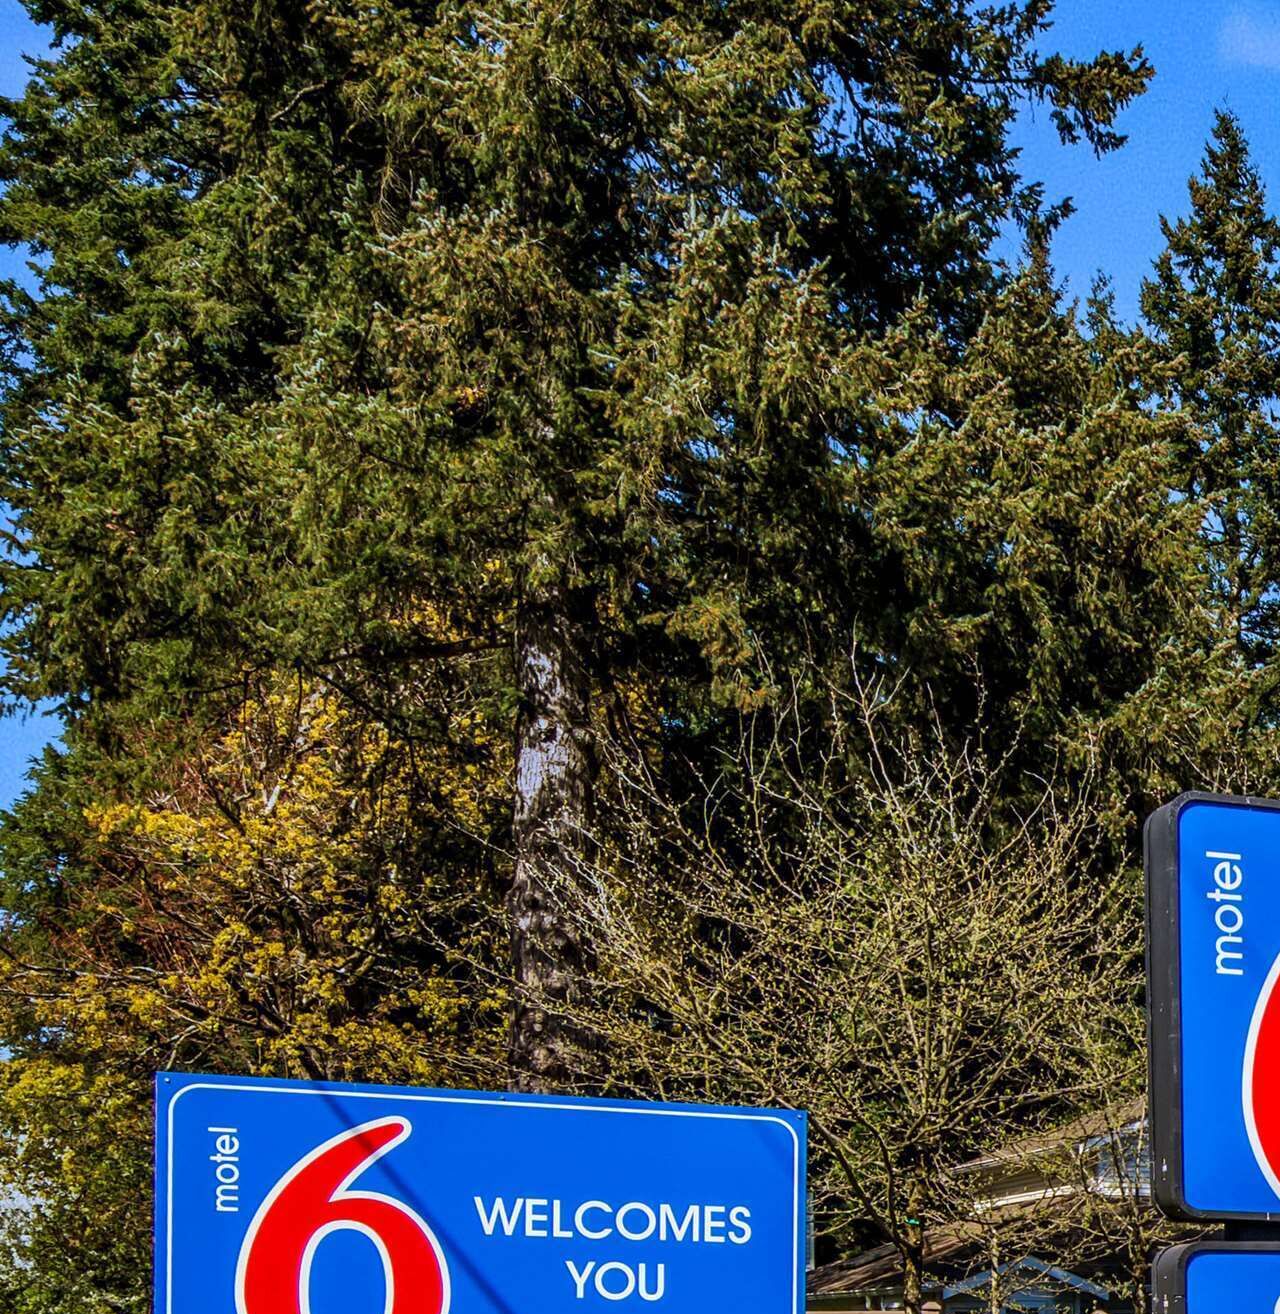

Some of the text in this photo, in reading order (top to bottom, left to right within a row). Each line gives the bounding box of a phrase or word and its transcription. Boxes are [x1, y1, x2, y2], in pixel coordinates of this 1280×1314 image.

[1205, 851, 1244, 976] motel
[207, 1126, 240, 1213] motel
[473, 1196, 753, 1245] WELCOMES
[565, 1260, 666, 1302] YOU
